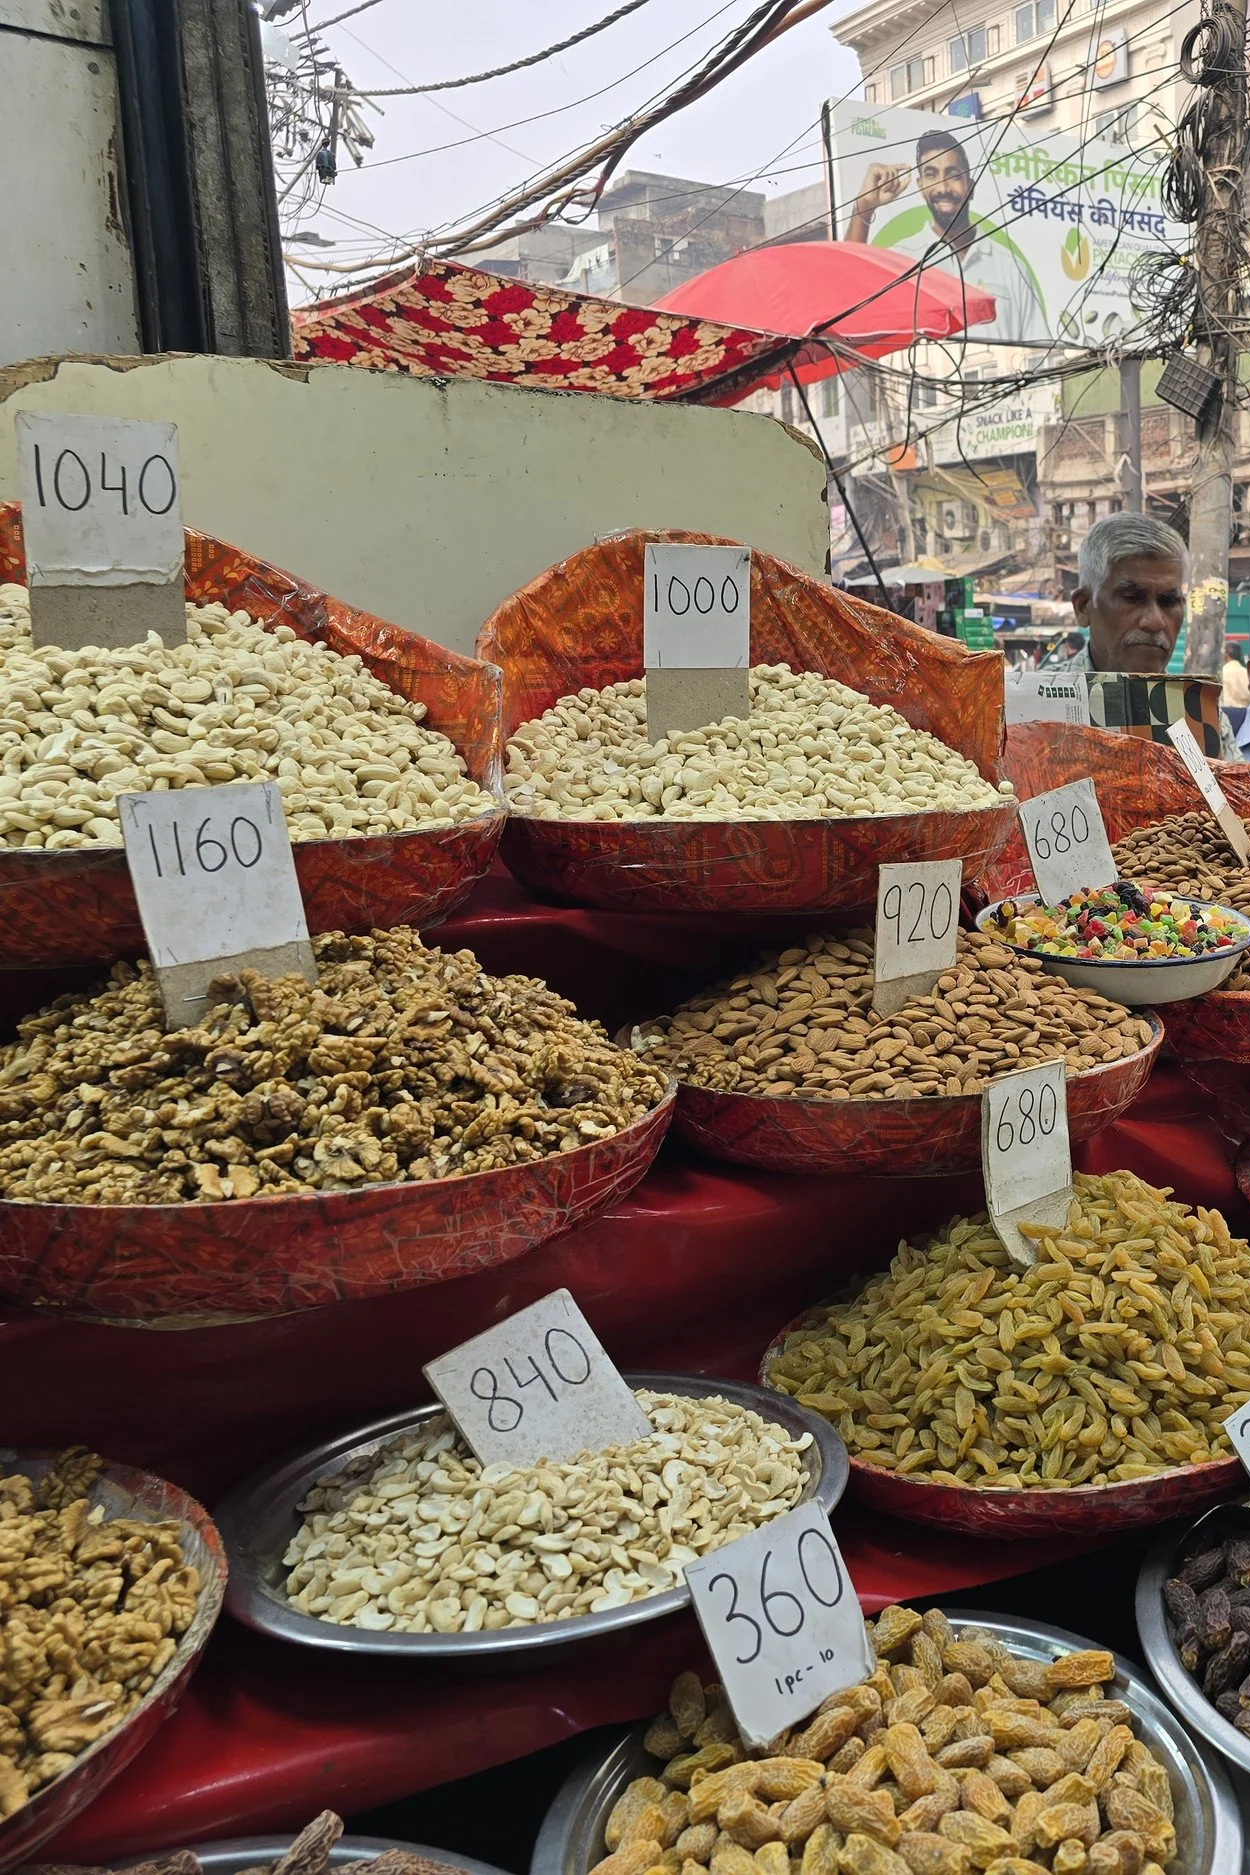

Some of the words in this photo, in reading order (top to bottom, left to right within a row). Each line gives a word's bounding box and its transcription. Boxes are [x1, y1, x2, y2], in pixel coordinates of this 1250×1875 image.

[1088, 198, 1117, 227] की
[1120, 206, 1167, 237] पसंद
[1006, 411, 1024, 425] LIKE
[1025, 408, 1032, 419] A
[33, 444, 177, 515] 1040
[653, 573, 741, 615] 1000
[146, 816, 263, 878] 1160
[1034, 805, 1090, 860] 680
[883, 882, 952, 946] 920
[997, 1083, 1057, 1152] 680
[469, 1328, 591, 1433] 840
[708, 1528, 844, 1664] 360
